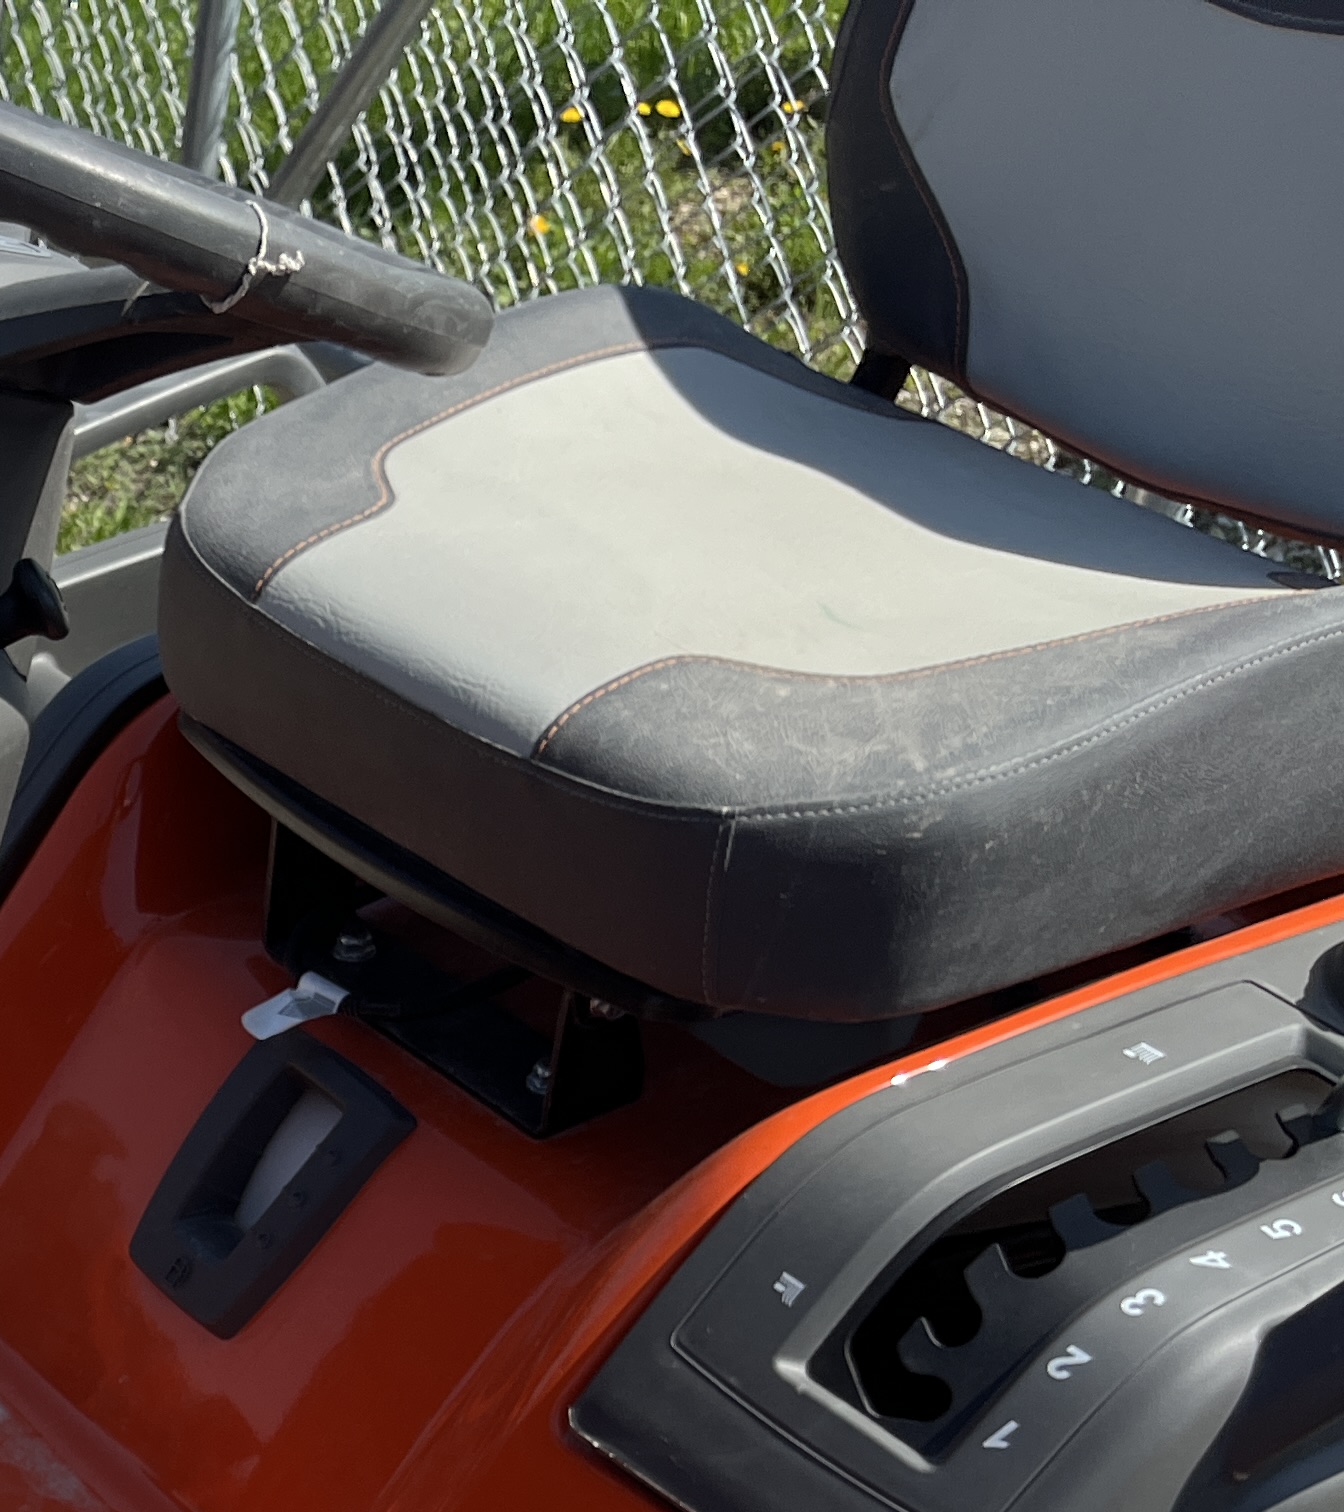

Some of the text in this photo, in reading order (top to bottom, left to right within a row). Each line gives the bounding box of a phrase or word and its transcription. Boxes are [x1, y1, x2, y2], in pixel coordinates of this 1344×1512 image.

[1260, 1218, 1303, 1240] 5
[1189, 1250, 1232, 1270] 4
[1120, 1288, 1166, 1317] 3
[1047, 1344, 1093, 1381] 2
[982, 1420, 1019, 1449] 1
